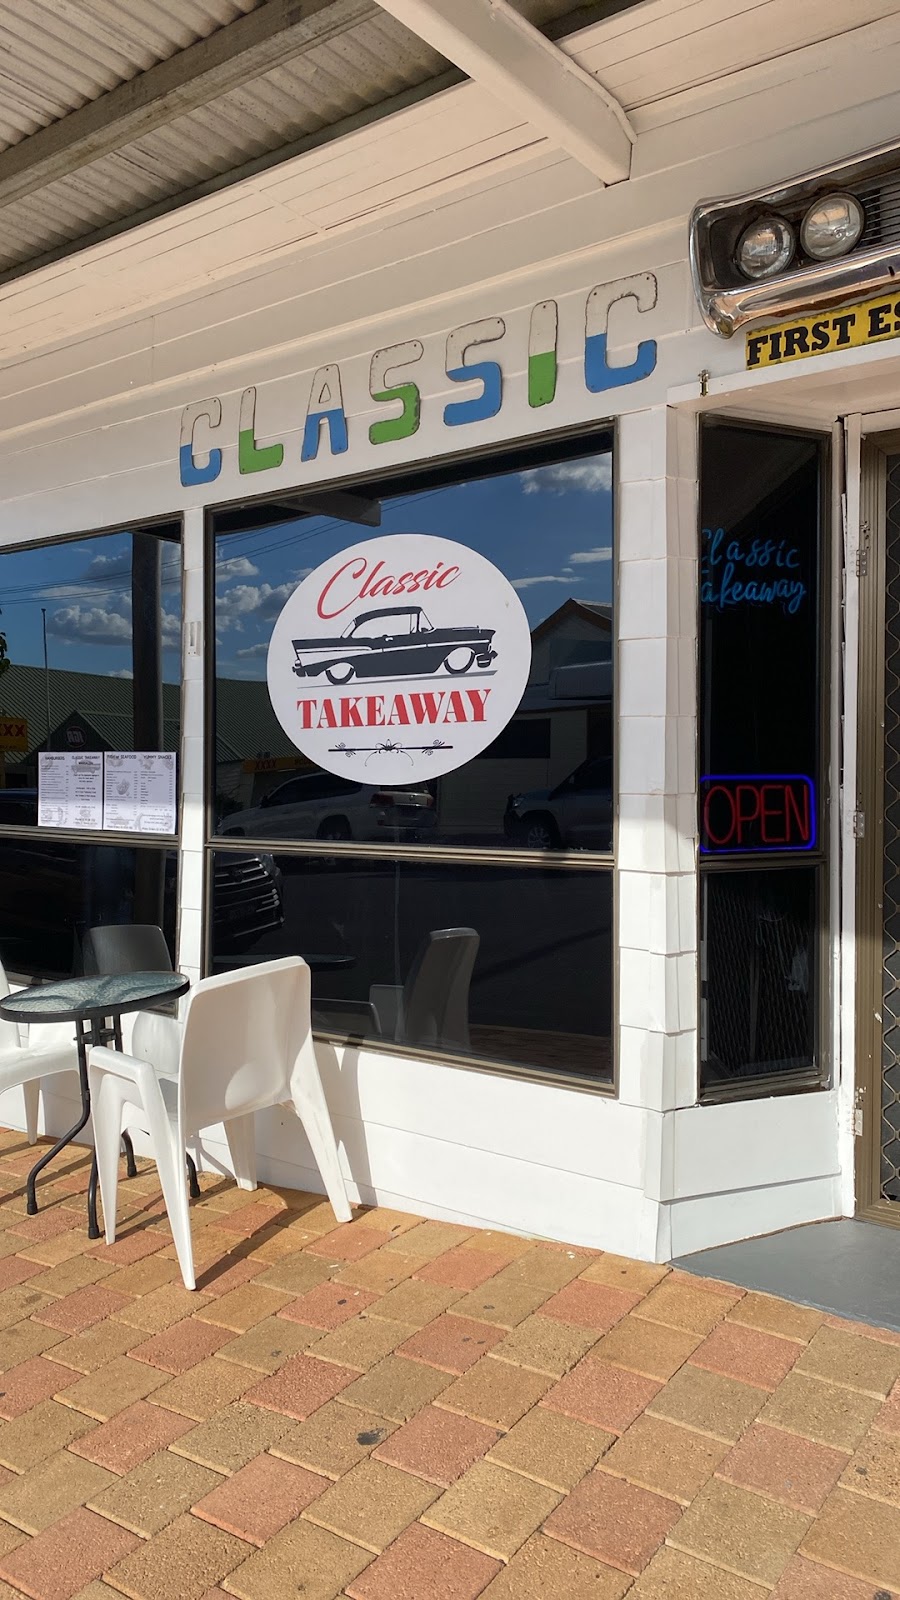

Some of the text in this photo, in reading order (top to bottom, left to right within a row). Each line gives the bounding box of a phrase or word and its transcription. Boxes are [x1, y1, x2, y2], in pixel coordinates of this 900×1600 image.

[747, 313, 856, 367] FIRST
[180, 272, 658, 487] CLASSIC
[316, 557, 462, 620] Classic
[701, 562, 807, 614] akeaway
[296, 688, 492, 730] TAKEAWAY
[703, 784, 809, 845] OPEN
